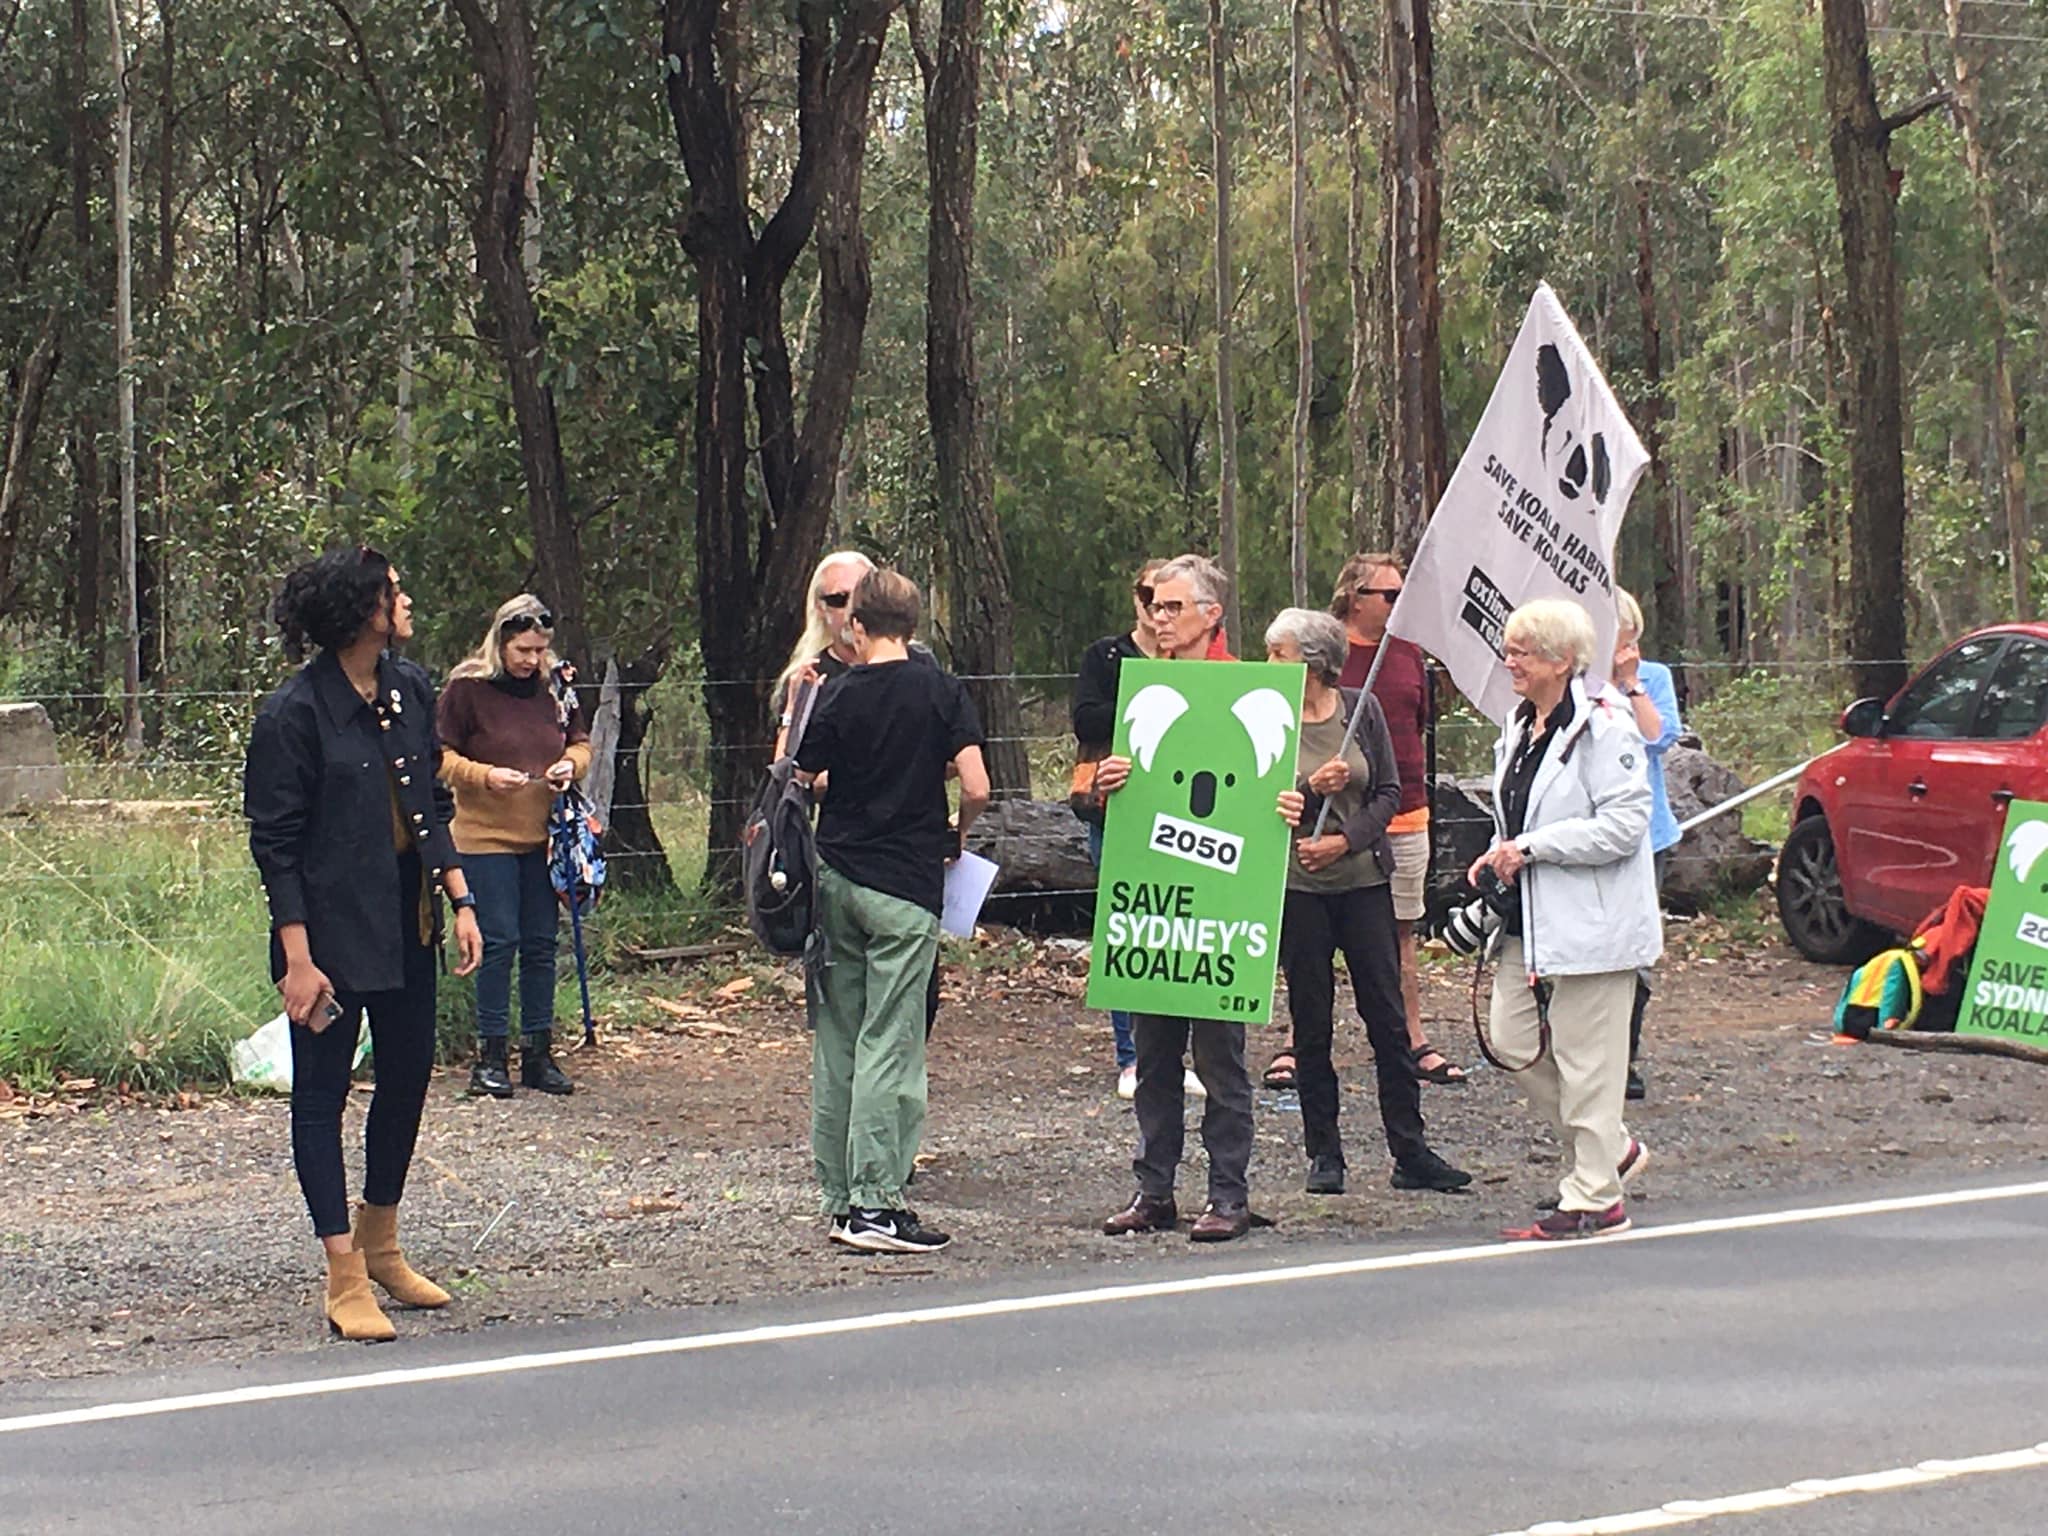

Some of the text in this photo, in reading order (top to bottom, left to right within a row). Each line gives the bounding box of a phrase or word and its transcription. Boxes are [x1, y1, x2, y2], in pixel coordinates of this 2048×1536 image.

[1483, 455, 1517, 497] SAVE
[1516, 488, 1560, 542] KOALA
[1498, 501, 1590, 594] SAVE KOALAS
[1155, 824, 1237, 865] 2050
[1111, 881, 1194, 917] SAVE
[1106, 912, 1268, 957] SYDNEY'S
[1104, 945, 1236, 987] KOALAS
[1981, 959, 2047, 989] SAVE
